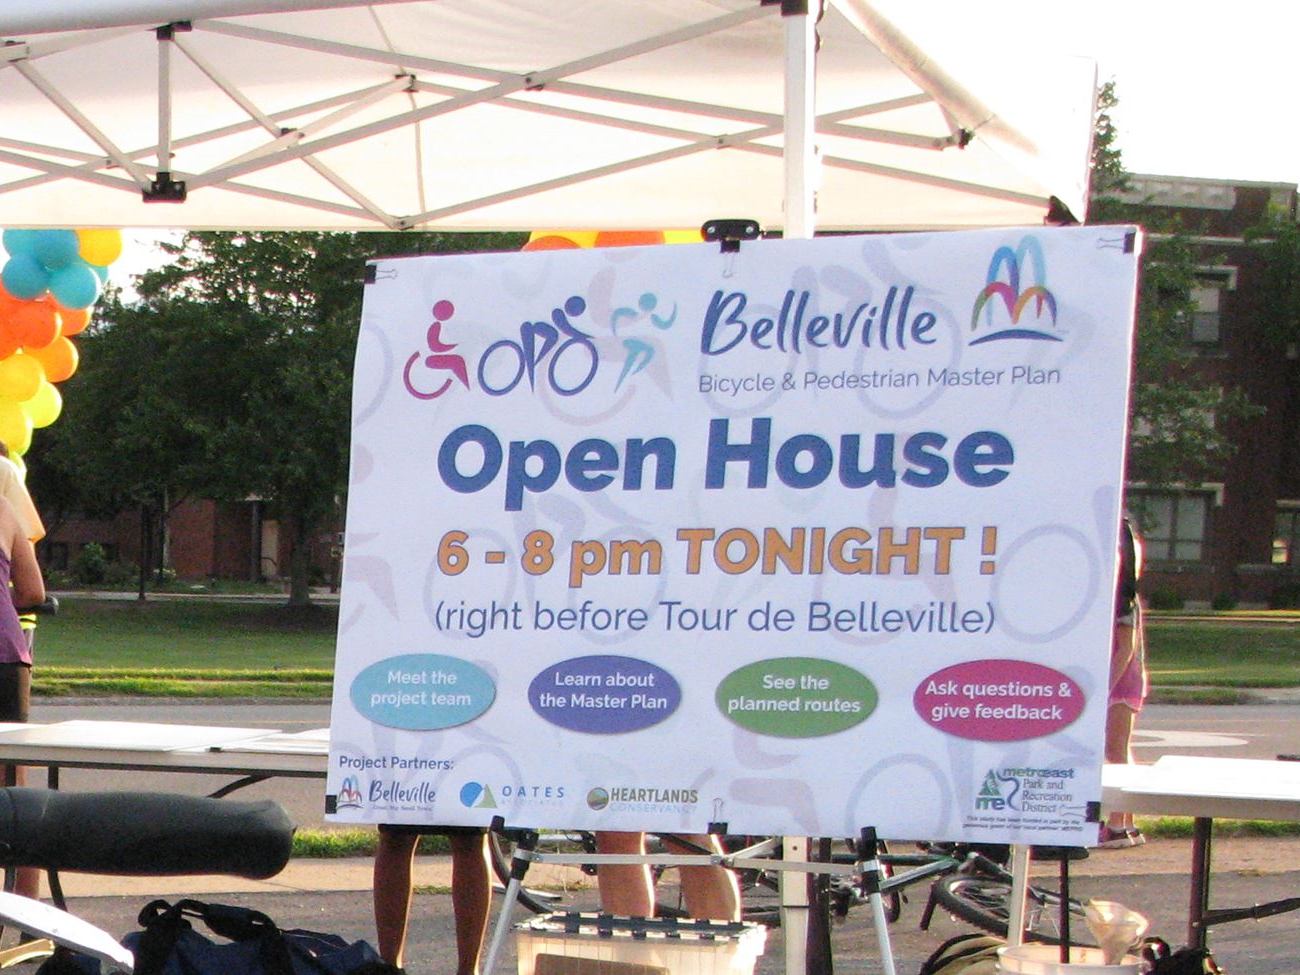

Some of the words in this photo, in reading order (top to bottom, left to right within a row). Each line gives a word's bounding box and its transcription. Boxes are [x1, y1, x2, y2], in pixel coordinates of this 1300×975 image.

[700, 286, 937, 356] Belleville
[700, 374, 775, 396] Bicycle
[782, 372, 797, 391] &
[804, 369, 919, 390] Pedestrian
[928, 366, 1004, 386] Master
[1012, 365, 1061, 385] Plan
[437, 424, 677, 512] Open
[704, 417, 1014, 490] House
[437, 529, 470, 575] 6
[485, 550, 506, 564] -
[520, 529, 554, 575] 8
[568, 538, 662, 588] pm
[676, 526, 965, 575] TONIGHT
[979, 526, 998, 575] !
[434, 601, 523, 639] (right
[533, 600, 648, 631] before
[658, 602, 738, 631] Tour
[747, 600, 795, 631] de
[809, 601, 996, 634] Belleville)
[388, 670, 429, 685] Meet
[431, 671, 457, 685] the
[555, 672, 601, 687] Learn
[605, 672, 654, 688] about
[763, 675, 797, 690] See
[800, 675, 829, 690] the
[925, 680, 957, 696] Ask
[962, 682, 1053, 700] questions
[1058, 682, 1072, 697] &
[371, 691, 427, 708] project
[431, 693, 471, 707] team
[539, 693, 567, 708] the
[570, 694, 628, 709] Master
[631, 695, 667, 710] Plan
[728, 696, 800, 715] planned
[804, 698, 861, 713] routes
[932, 704, 970, 722] give
[975, 702, 1063, 720] feedback
[339, 756, 387, 771] Project
[391, 757, 454, 770] Partners:
[369, 780, 437, 804] Belleville
[502, 786, 565, 798] OATES
[1022, 778, 1043, 789] Park
[1046, 780, 1064, 790] and
[611, 788, 698, 804] HEARTLANDS
[1022, 790, 1073, 802] Recreation
